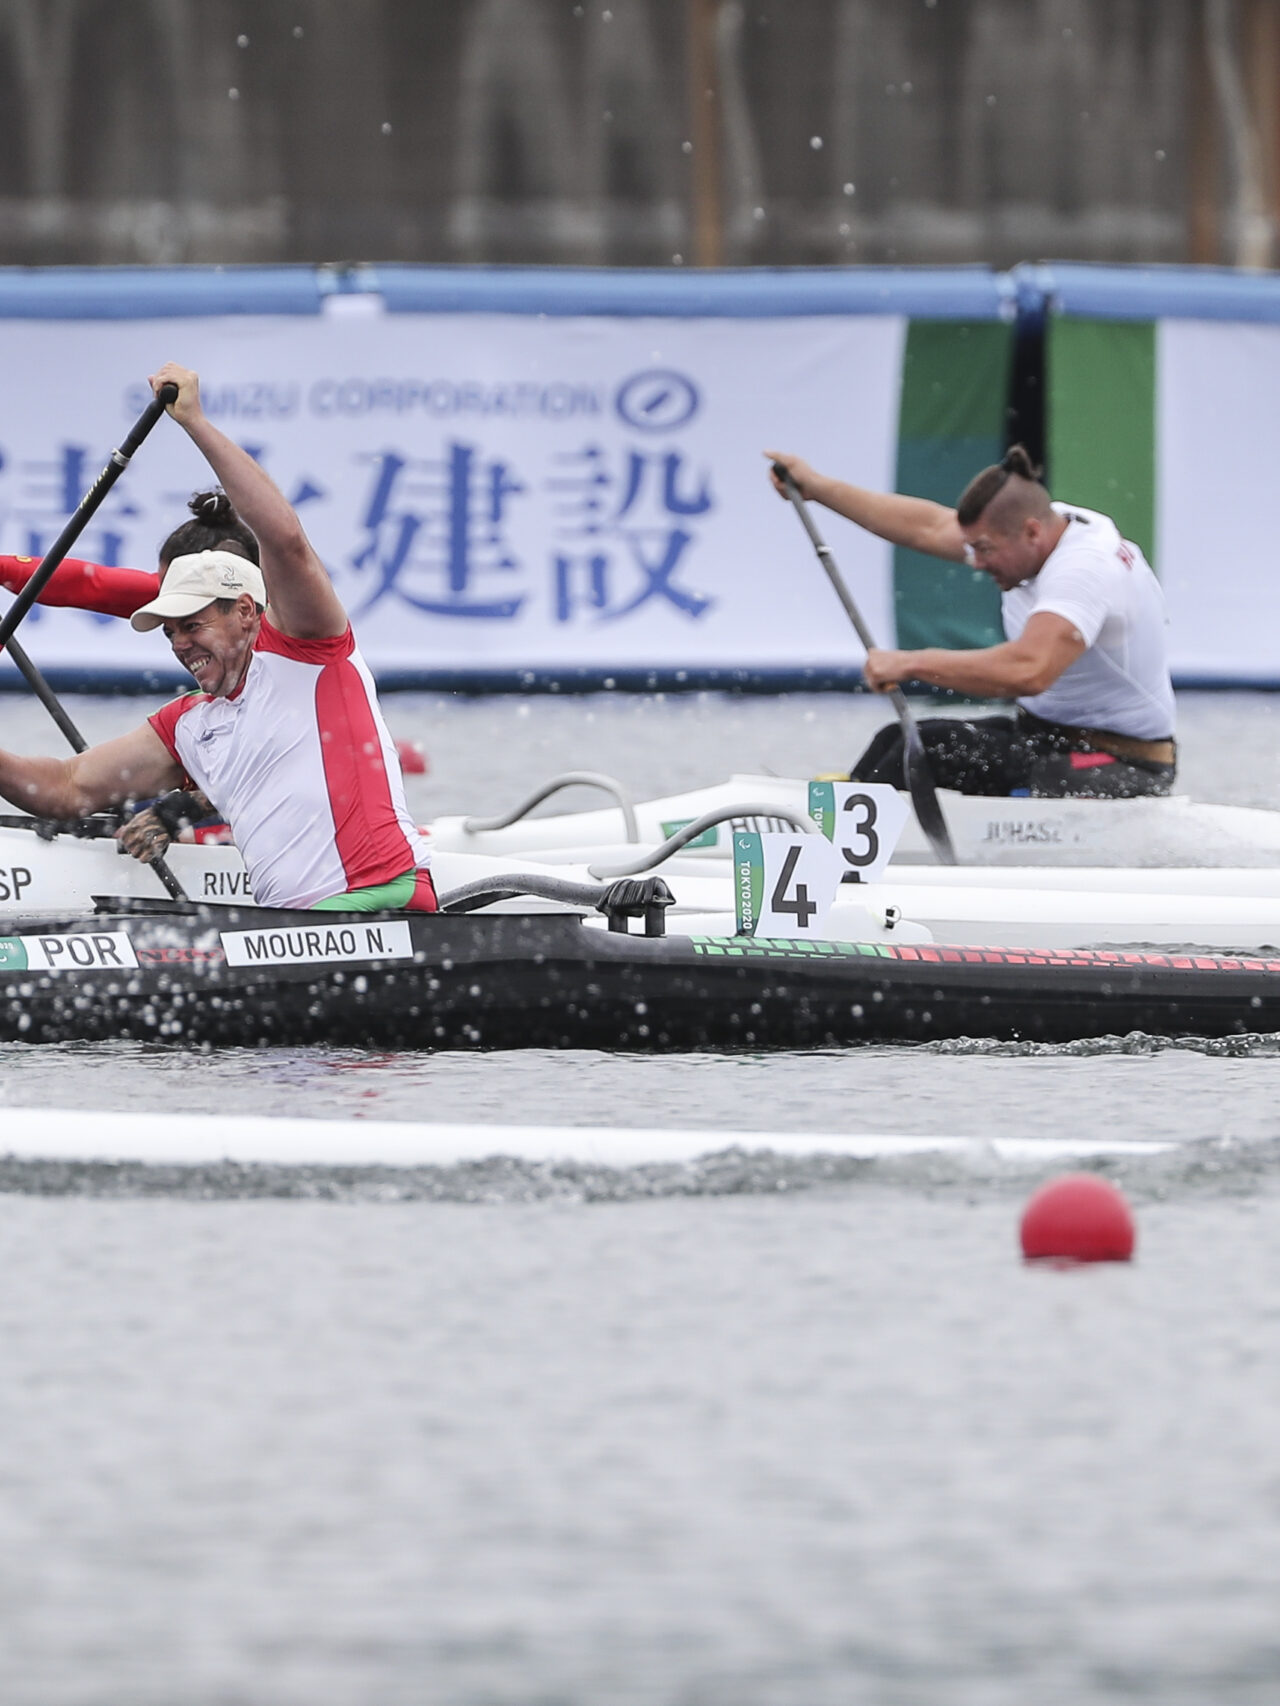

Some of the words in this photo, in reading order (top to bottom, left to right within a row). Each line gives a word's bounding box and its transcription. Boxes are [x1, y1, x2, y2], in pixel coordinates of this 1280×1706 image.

[123, 381, 300, 420] SMIZU
[308, 379, 602, 420] CORPORATION
[842, 793, 879, 867] 3
[740, 861, 752, 900] TOKYO
[771, 846, 816, 928] 4
[742, 901, 753, 930] 2020
[39, 934, 125, 967] POR
[244, 929, 357, 960] MOURAO
[366, 928, 393, 954] N.
